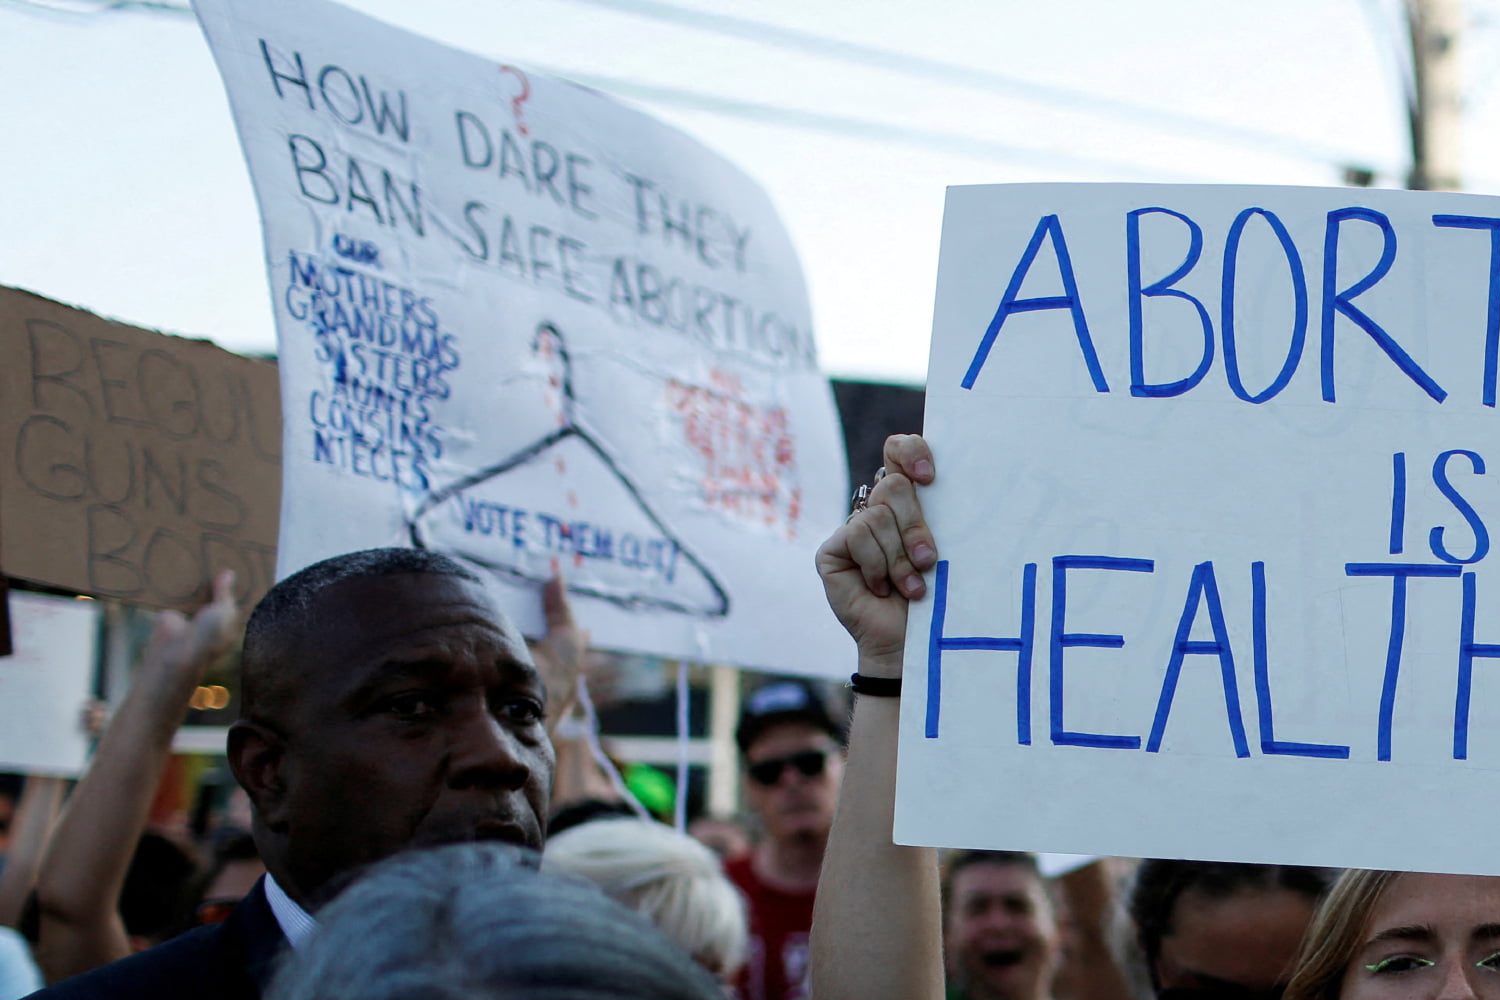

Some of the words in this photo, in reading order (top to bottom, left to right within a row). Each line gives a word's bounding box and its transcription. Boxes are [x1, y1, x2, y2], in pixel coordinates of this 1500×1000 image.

[258, 37, 409, 143] HOW
[455, 109, 600, 222] DARE
[624, 171, 752, 273] THEY
[287, 133, 426, 237] BAN
[450, 201, 597, 303] SAFE
[286, 283, 460, 371] GRANDMAS
[289, 248, 438, 331] MOTHERS
[15, 414, 249, 533] GUNS
[455, 491, 528, 549] VOTE
[536, 511, 614, 559] THEM
[1388, 448, 1491, 565] IS
